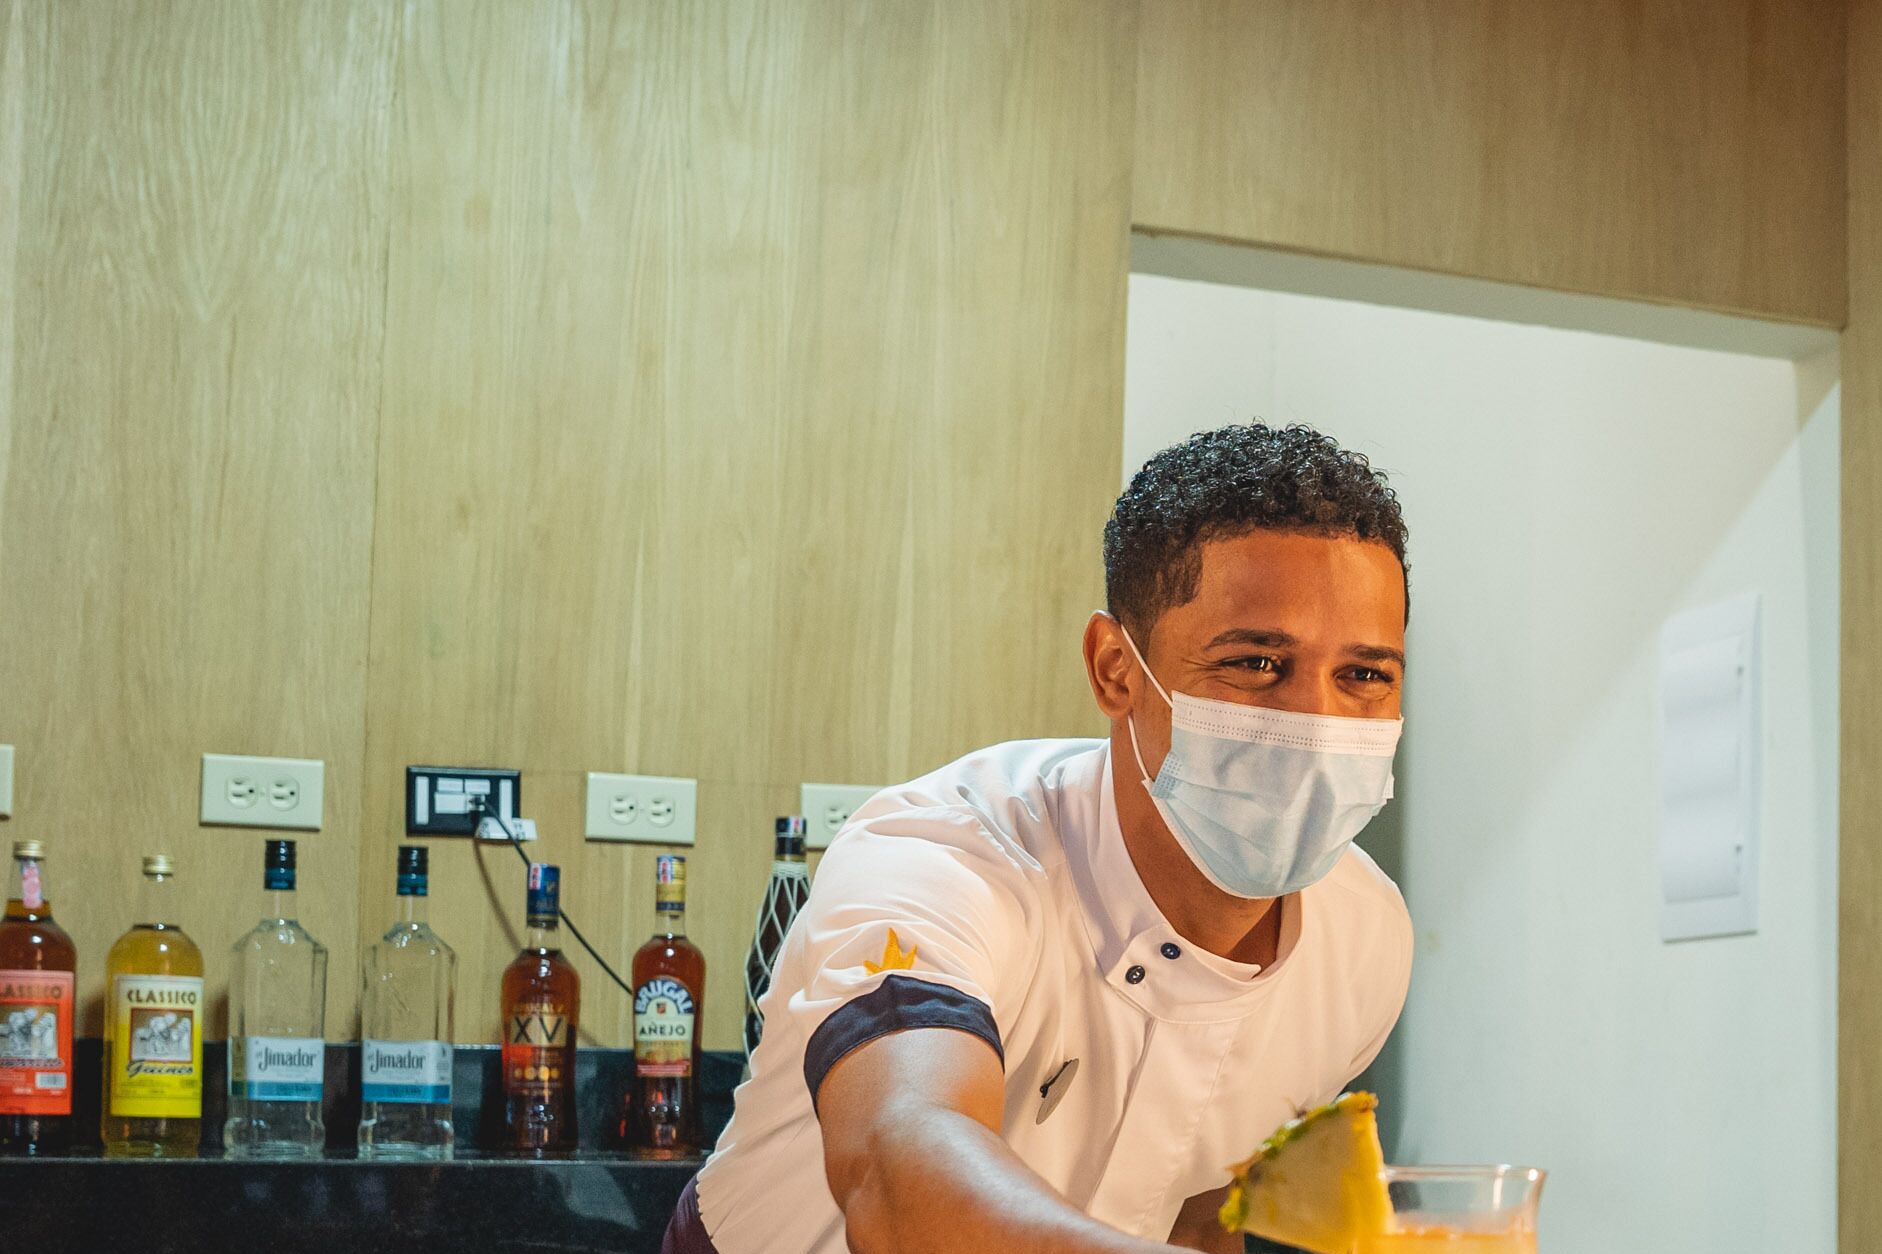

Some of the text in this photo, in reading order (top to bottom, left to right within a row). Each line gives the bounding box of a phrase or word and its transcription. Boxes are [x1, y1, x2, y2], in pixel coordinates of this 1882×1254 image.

[127, 989, 197, 1005] CLASSICO
[635, 980, 693, 1013] BRUGAL
[640, 1022, 686, 1036] AÑEJO
[259, 1046, 317, 1071] Jimador
[370, 1048, 425, 1072] Jimador
